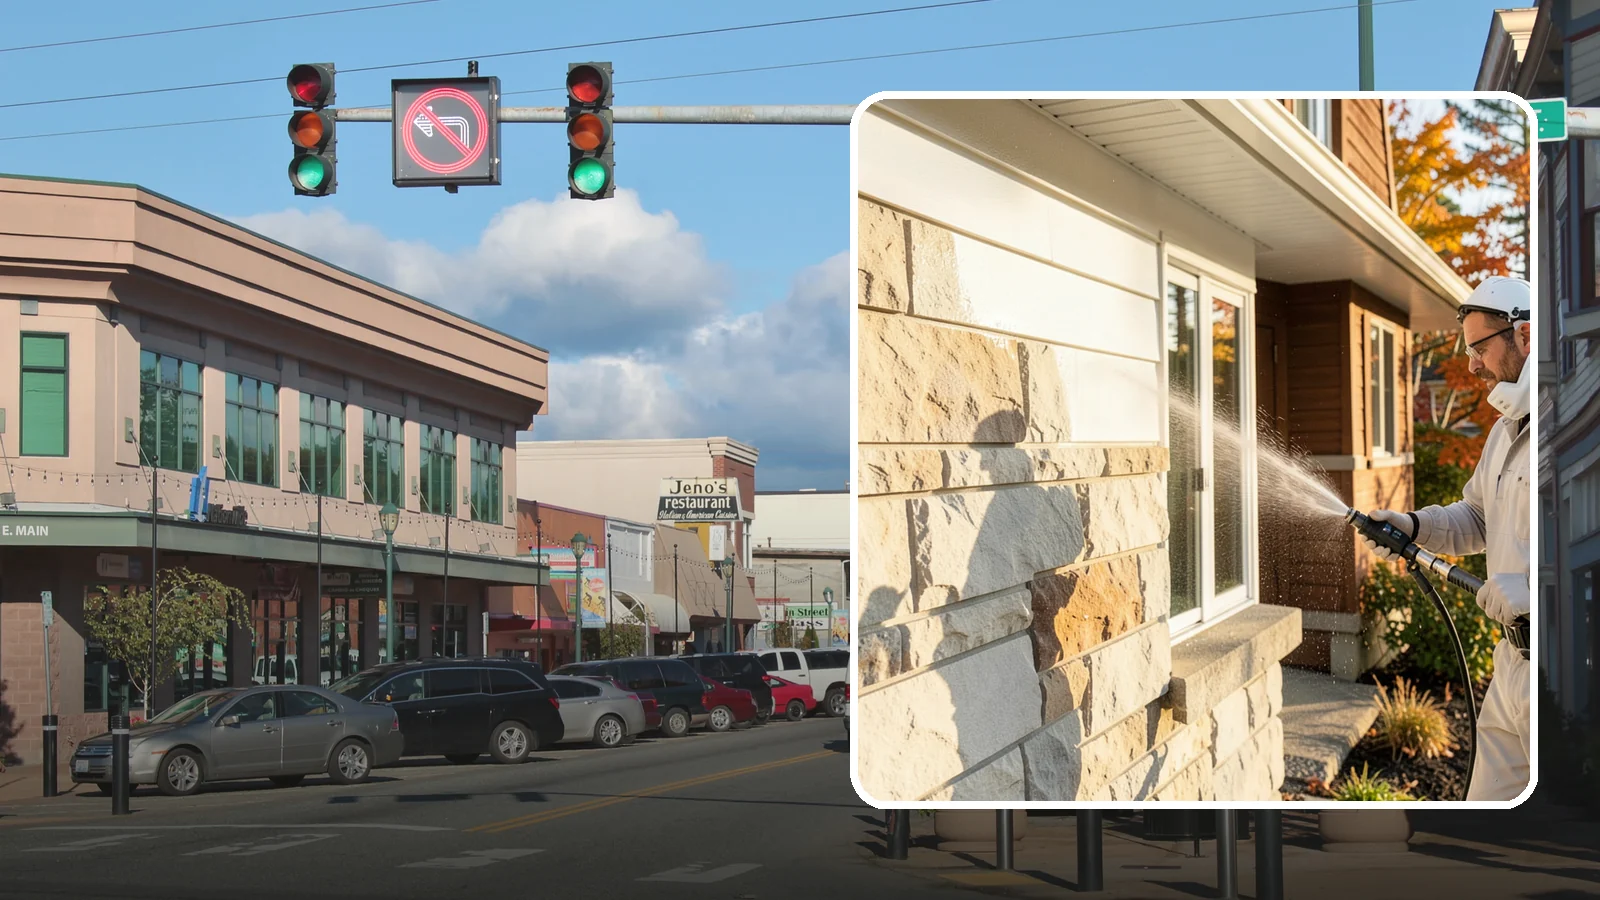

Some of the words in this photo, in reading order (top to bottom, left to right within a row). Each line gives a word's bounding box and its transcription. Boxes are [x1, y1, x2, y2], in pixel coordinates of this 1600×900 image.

[669, 480, 728, 495] Jeno's
[665, 496, 731, 509] restaurant
[658, 509, 682, 520] Italian
[686, 509, 715, 520] American
[714, 509, 738, 520] Cuisine
[2, 525, 13, 536] E.
[15, 525, 49, 536] MAIN
[797, 607, 829, 617] Street
